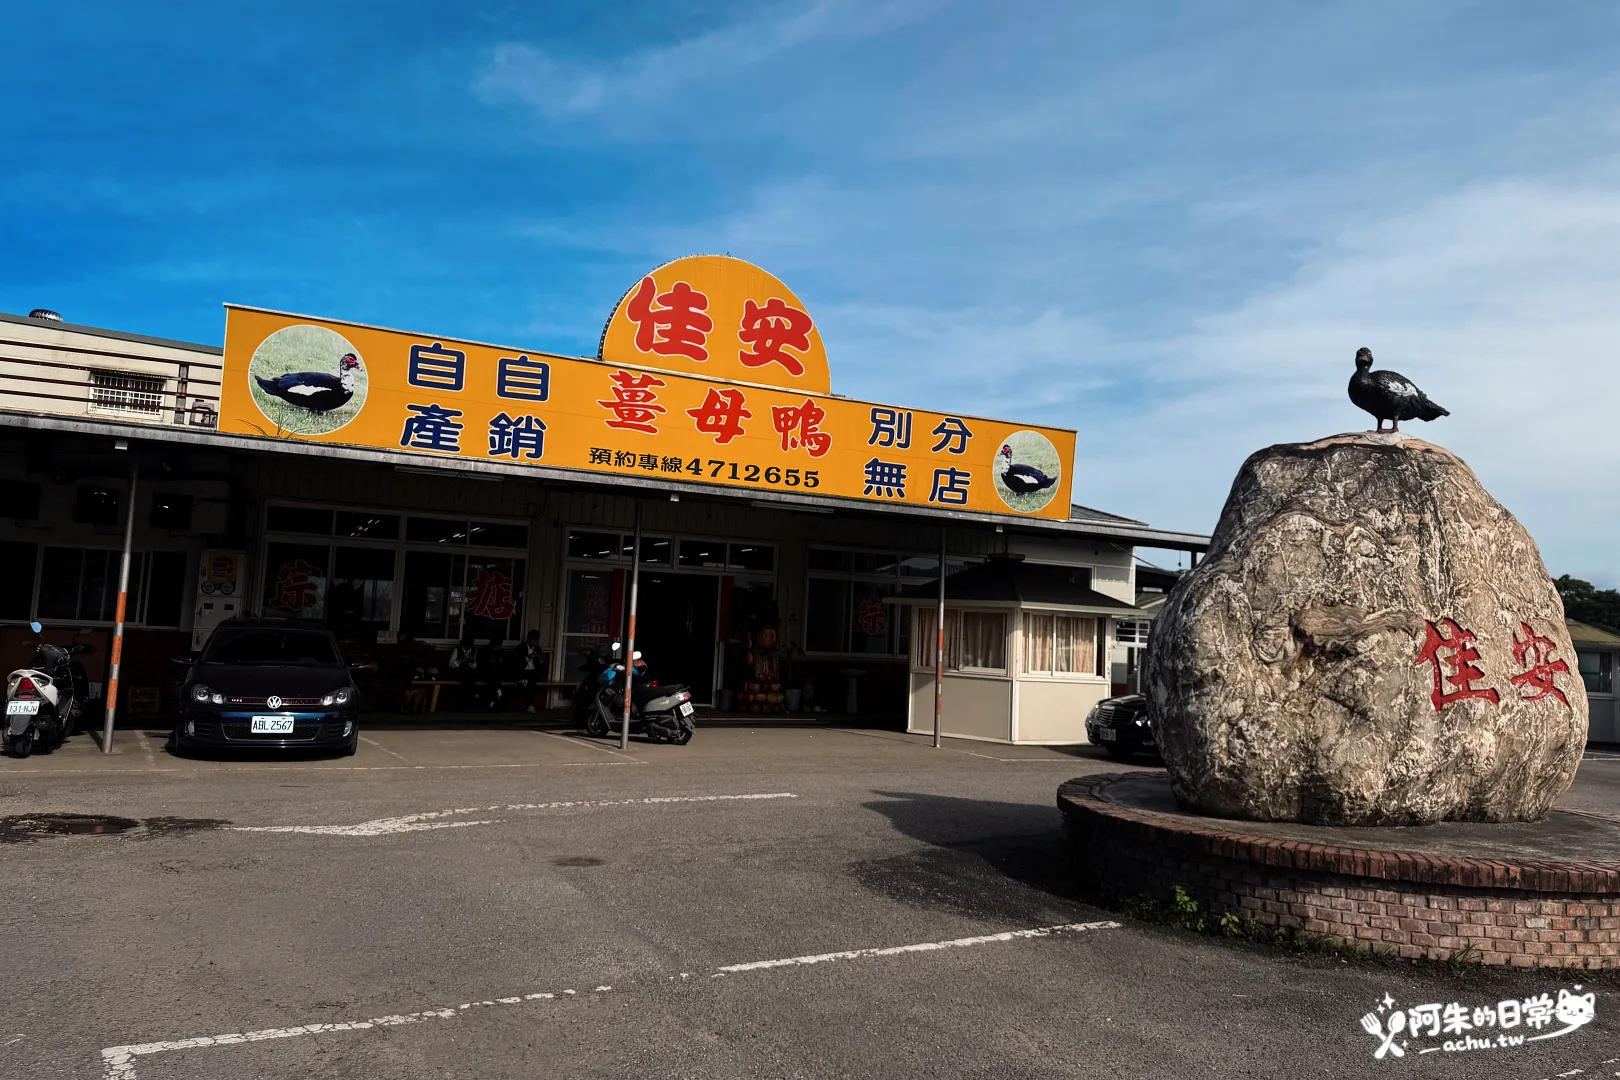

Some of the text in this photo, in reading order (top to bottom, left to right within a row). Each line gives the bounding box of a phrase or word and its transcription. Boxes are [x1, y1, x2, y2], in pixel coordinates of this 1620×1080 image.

[626, 276, 814, 376] 佳安
[597, 369, 832, 458] 薑母鴨
[1413, 617, 1571, 713] 佳安
